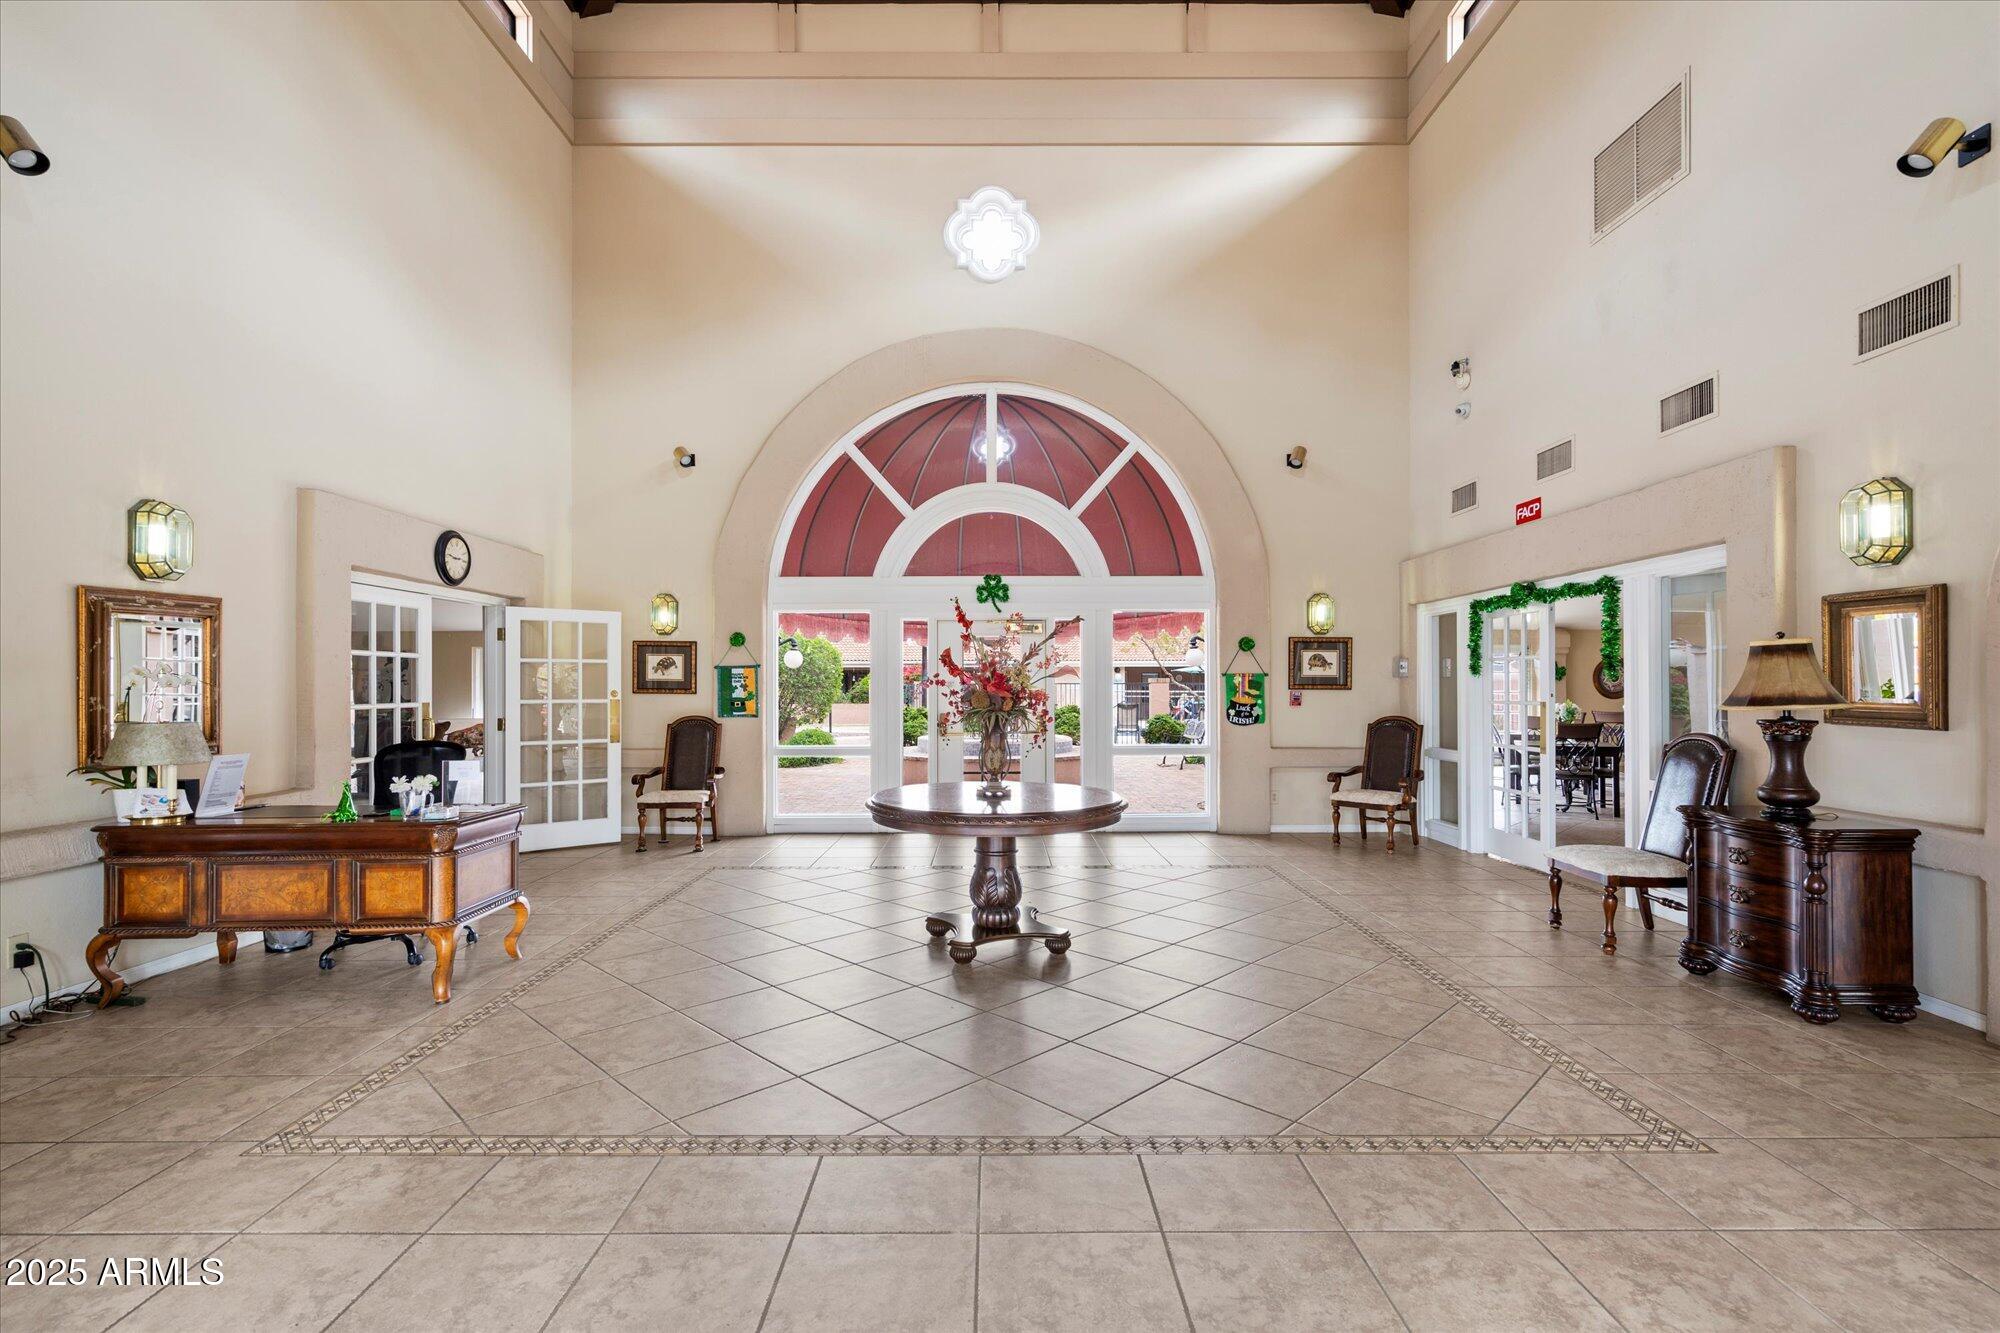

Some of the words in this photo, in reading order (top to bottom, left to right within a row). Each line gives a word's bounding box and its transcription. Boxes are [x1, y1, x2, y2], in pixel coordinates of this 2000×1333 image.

[1517, 503, 1540, 520] FACP
[1236, 703, 1251, 711] Luck
[1229, 716, 1255, 724] IRISH!
